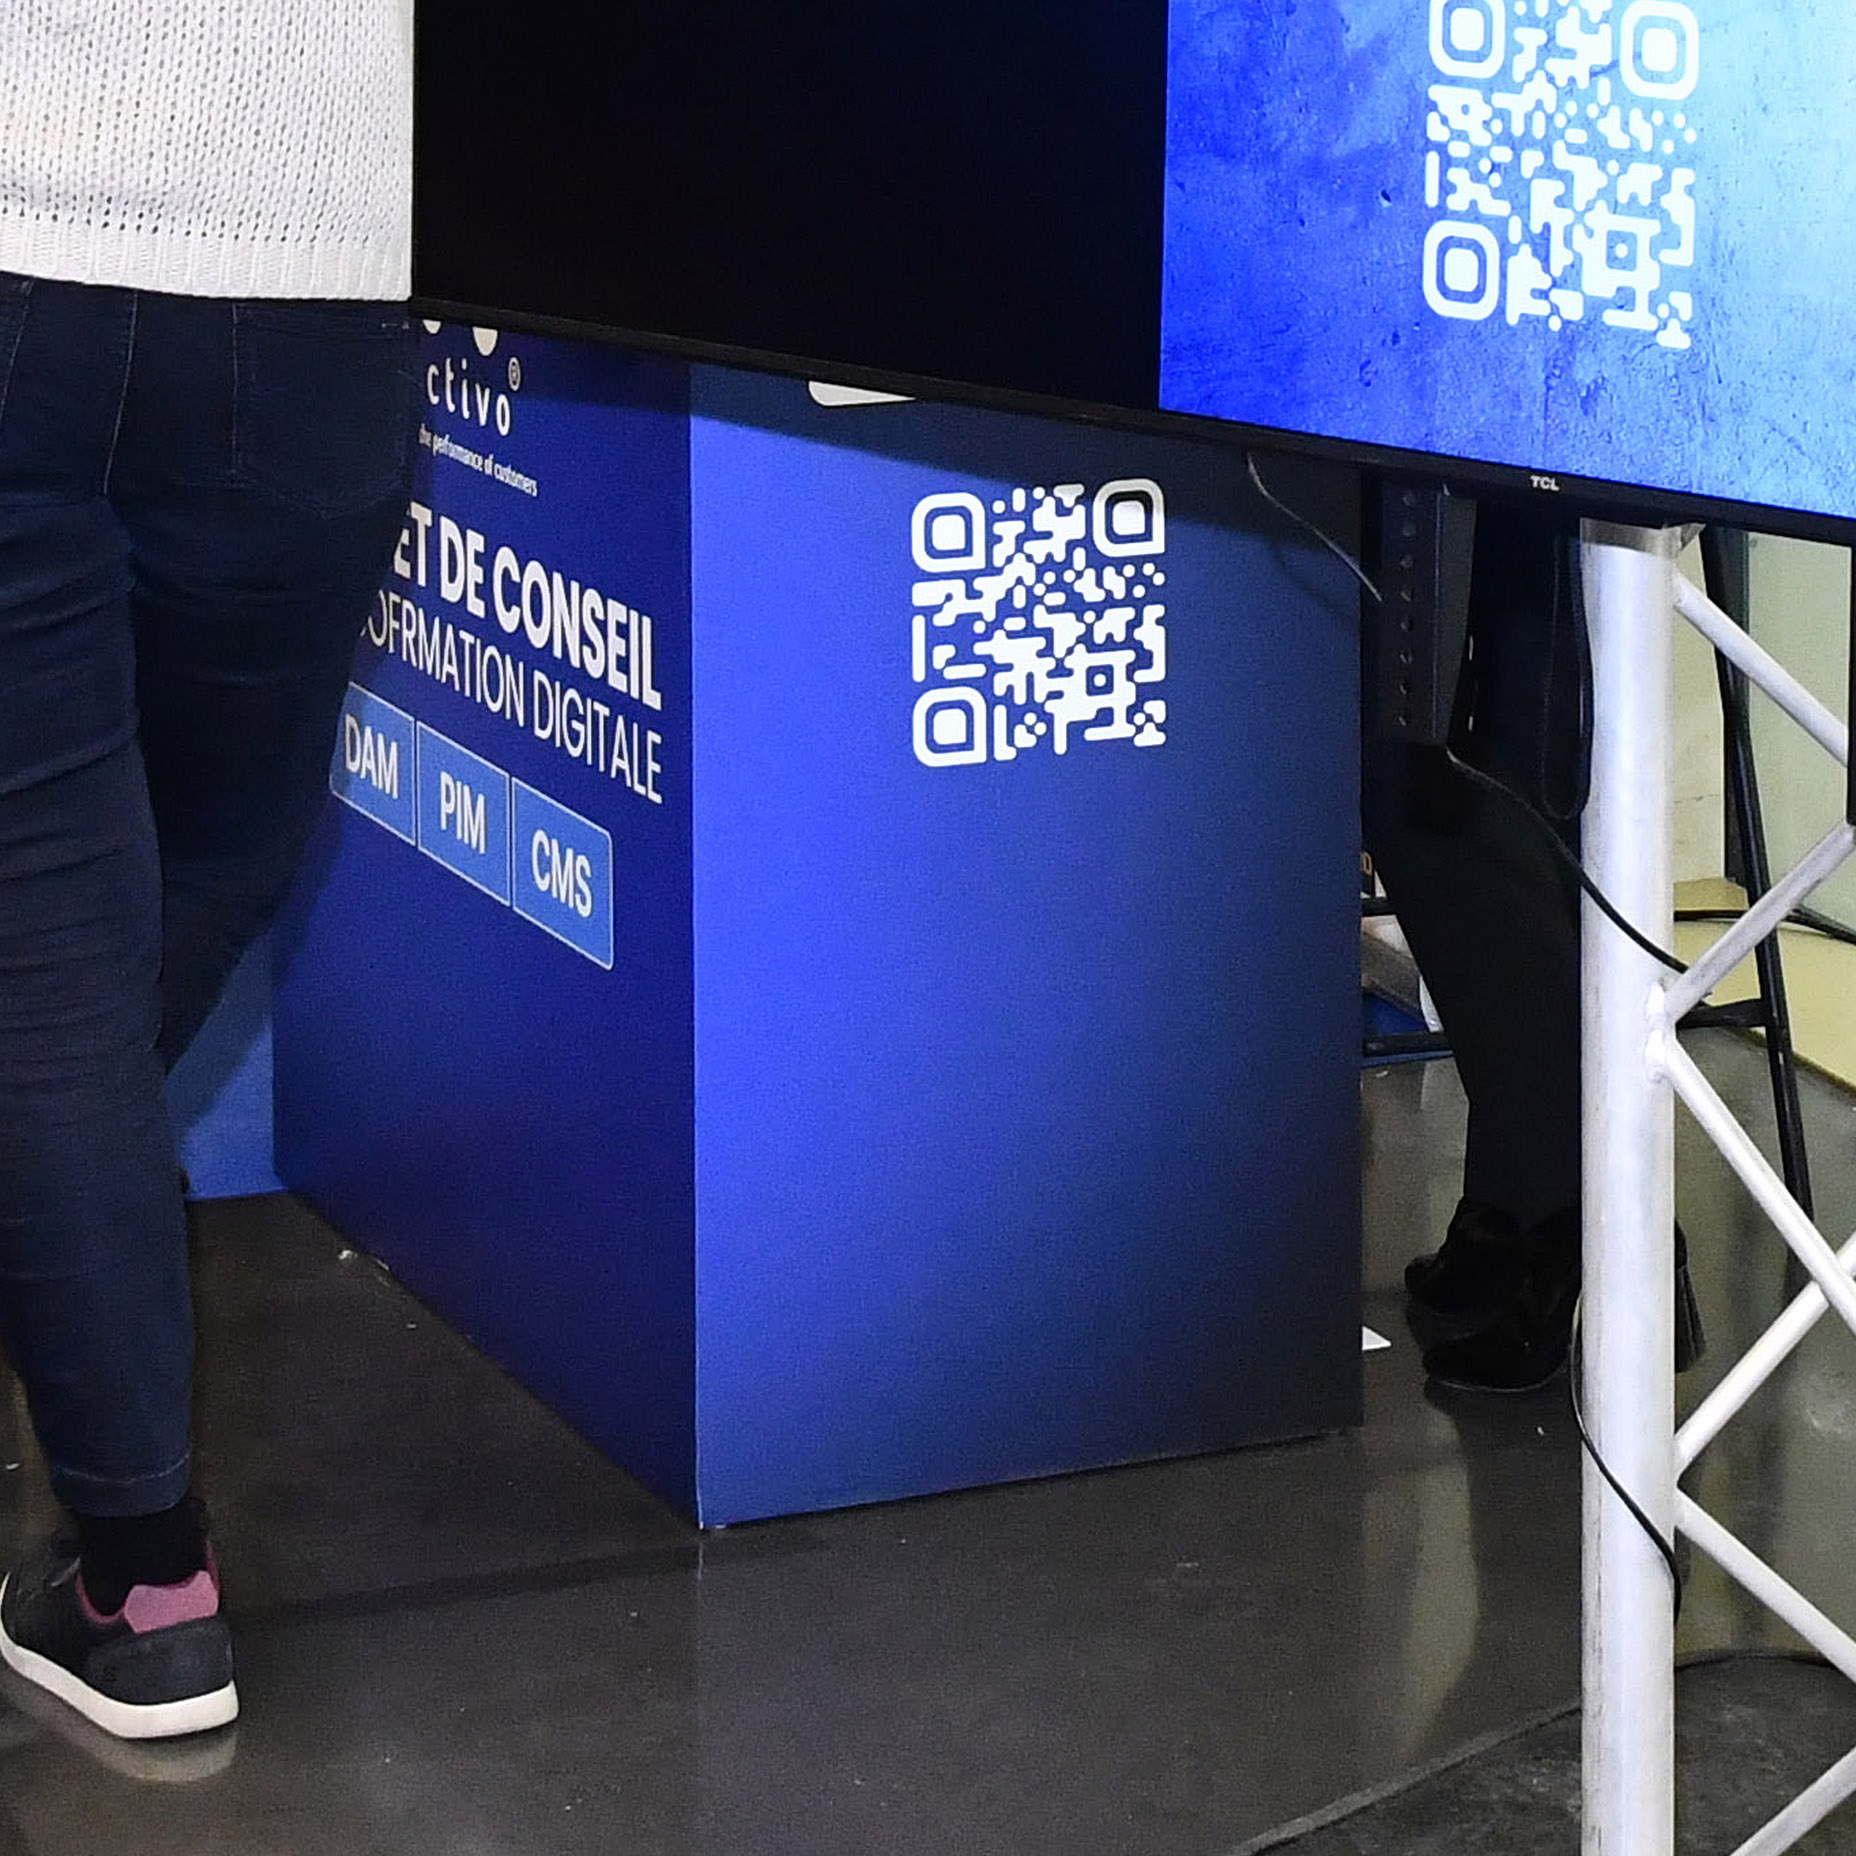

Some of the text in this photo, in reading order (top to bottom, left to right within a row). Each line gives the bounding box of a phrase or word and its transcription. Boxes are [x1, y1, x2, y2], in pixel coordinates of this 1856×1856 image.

[1530, 475, 1560, 491] TCL
[440, 516, 485, 619] DE
[493, 546, 662, 711] CONSEIL
[345, 713, 592, 918] DAM PIM CMS
[534, 670, 662, 804] DIGITALE
